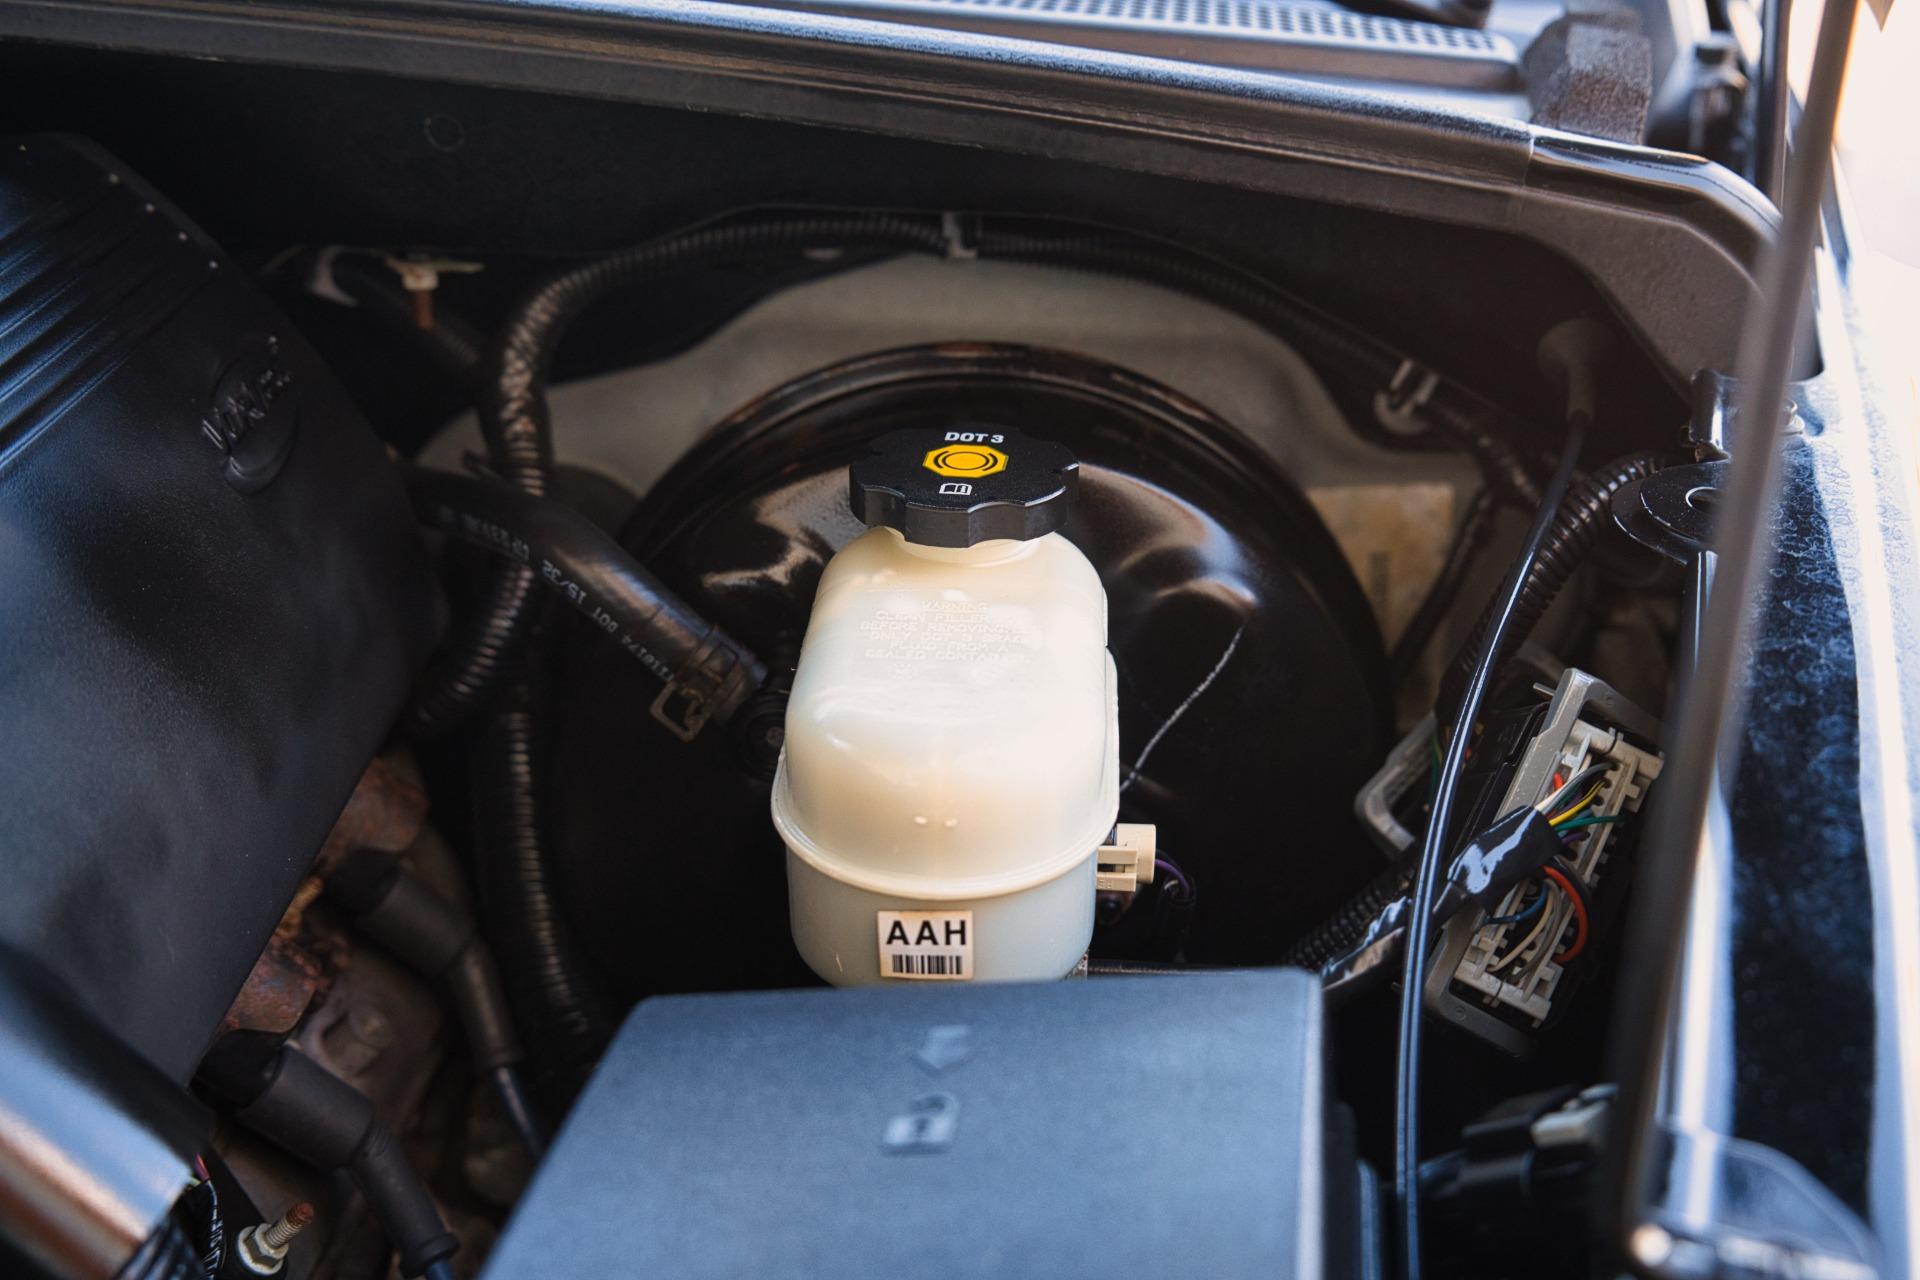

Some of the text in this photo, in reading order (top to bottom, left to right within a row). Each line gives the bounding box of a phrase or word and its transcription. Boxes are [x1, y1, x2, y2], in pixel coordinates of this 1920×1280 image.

[944, 432, 1005, 444] DOT 3
[542, 559, 587, 605] 15/32
[921, 600, 989, 611] WARNING
[591, 607, 619, 633] DOT
[935, 613, 992, 624] FILLER
[860, 620, 918, 632] BEFORE
[870, 631, 912, 641] ONLY
[921, 632, 953, 642] DOT
[890, 640, 938, 651] FLUID
[947, 641, 990, 652] FROM
[864, 648, 927, 660] SEALED
[886, 920, 968, 946] AAH
